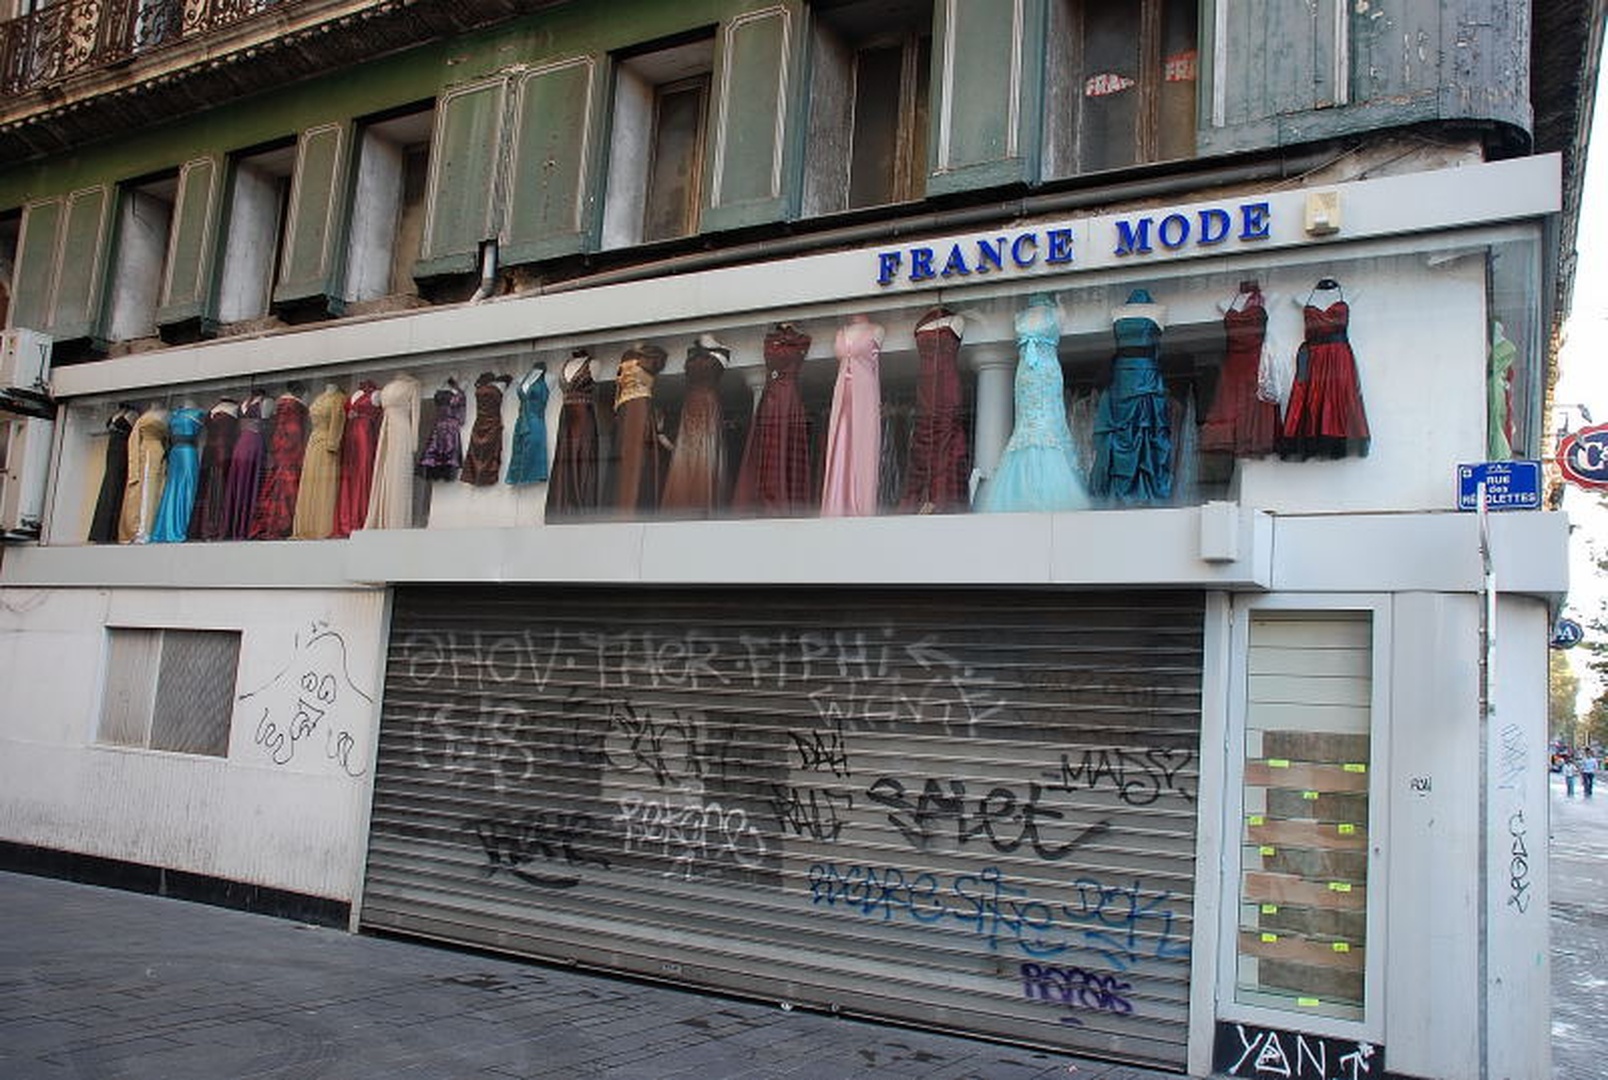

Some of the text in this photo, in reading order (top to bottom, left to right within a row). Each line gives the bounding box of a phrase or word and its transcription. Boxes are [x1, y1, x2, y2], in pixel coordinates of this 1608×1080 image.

[877, 202, 1271, 285] FRANCE MODE
[1486, 475, 1511, 485] RUE
[1463, 492, 1537, 505] RÉOLETTES
